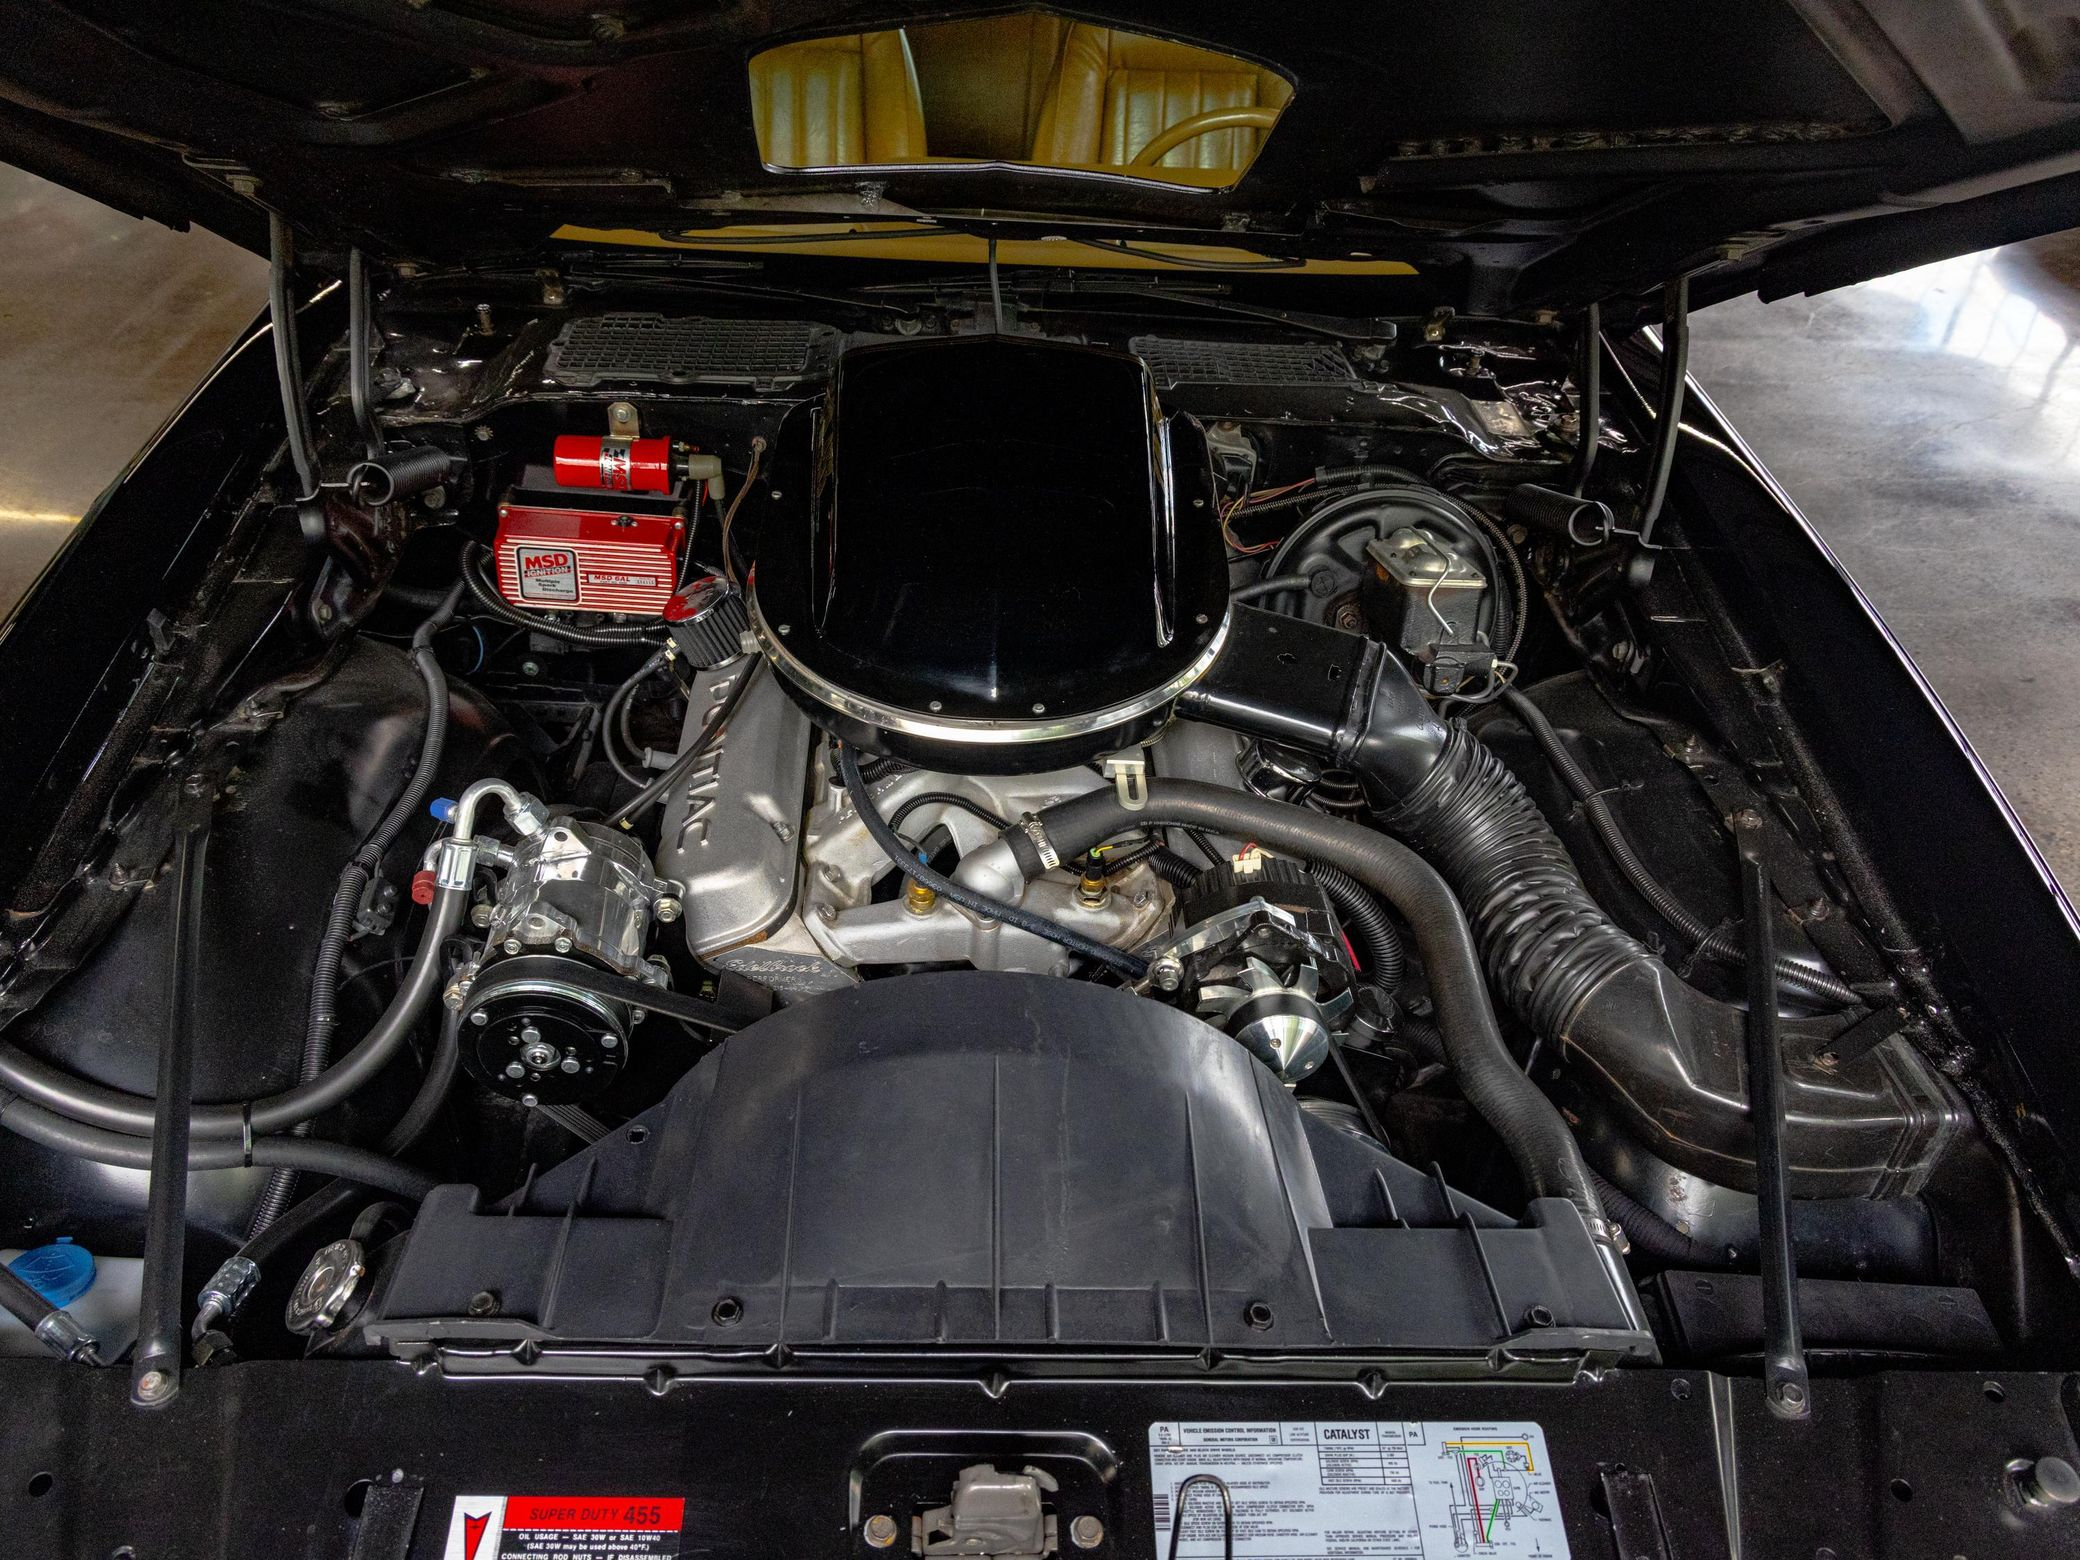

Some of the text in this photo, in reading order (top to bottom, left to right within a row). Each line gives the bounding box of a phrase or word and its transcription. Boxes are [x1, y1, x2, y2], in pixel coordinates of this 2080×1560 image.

[525, 553, 569, 570] MSD
[527, 566, 569, 578] IGNITION
[722, 959, 821, 974] Edelbrock
[1323, 1428, 1371, 1440] CATALYST
[529, 1505, 662, 1525] SUPER DUTY 455
[572, 1533, 587, 1541] SAE
[638, 1534, 662, 1542] 10W40
[589, 1543, 607, 1551] used
